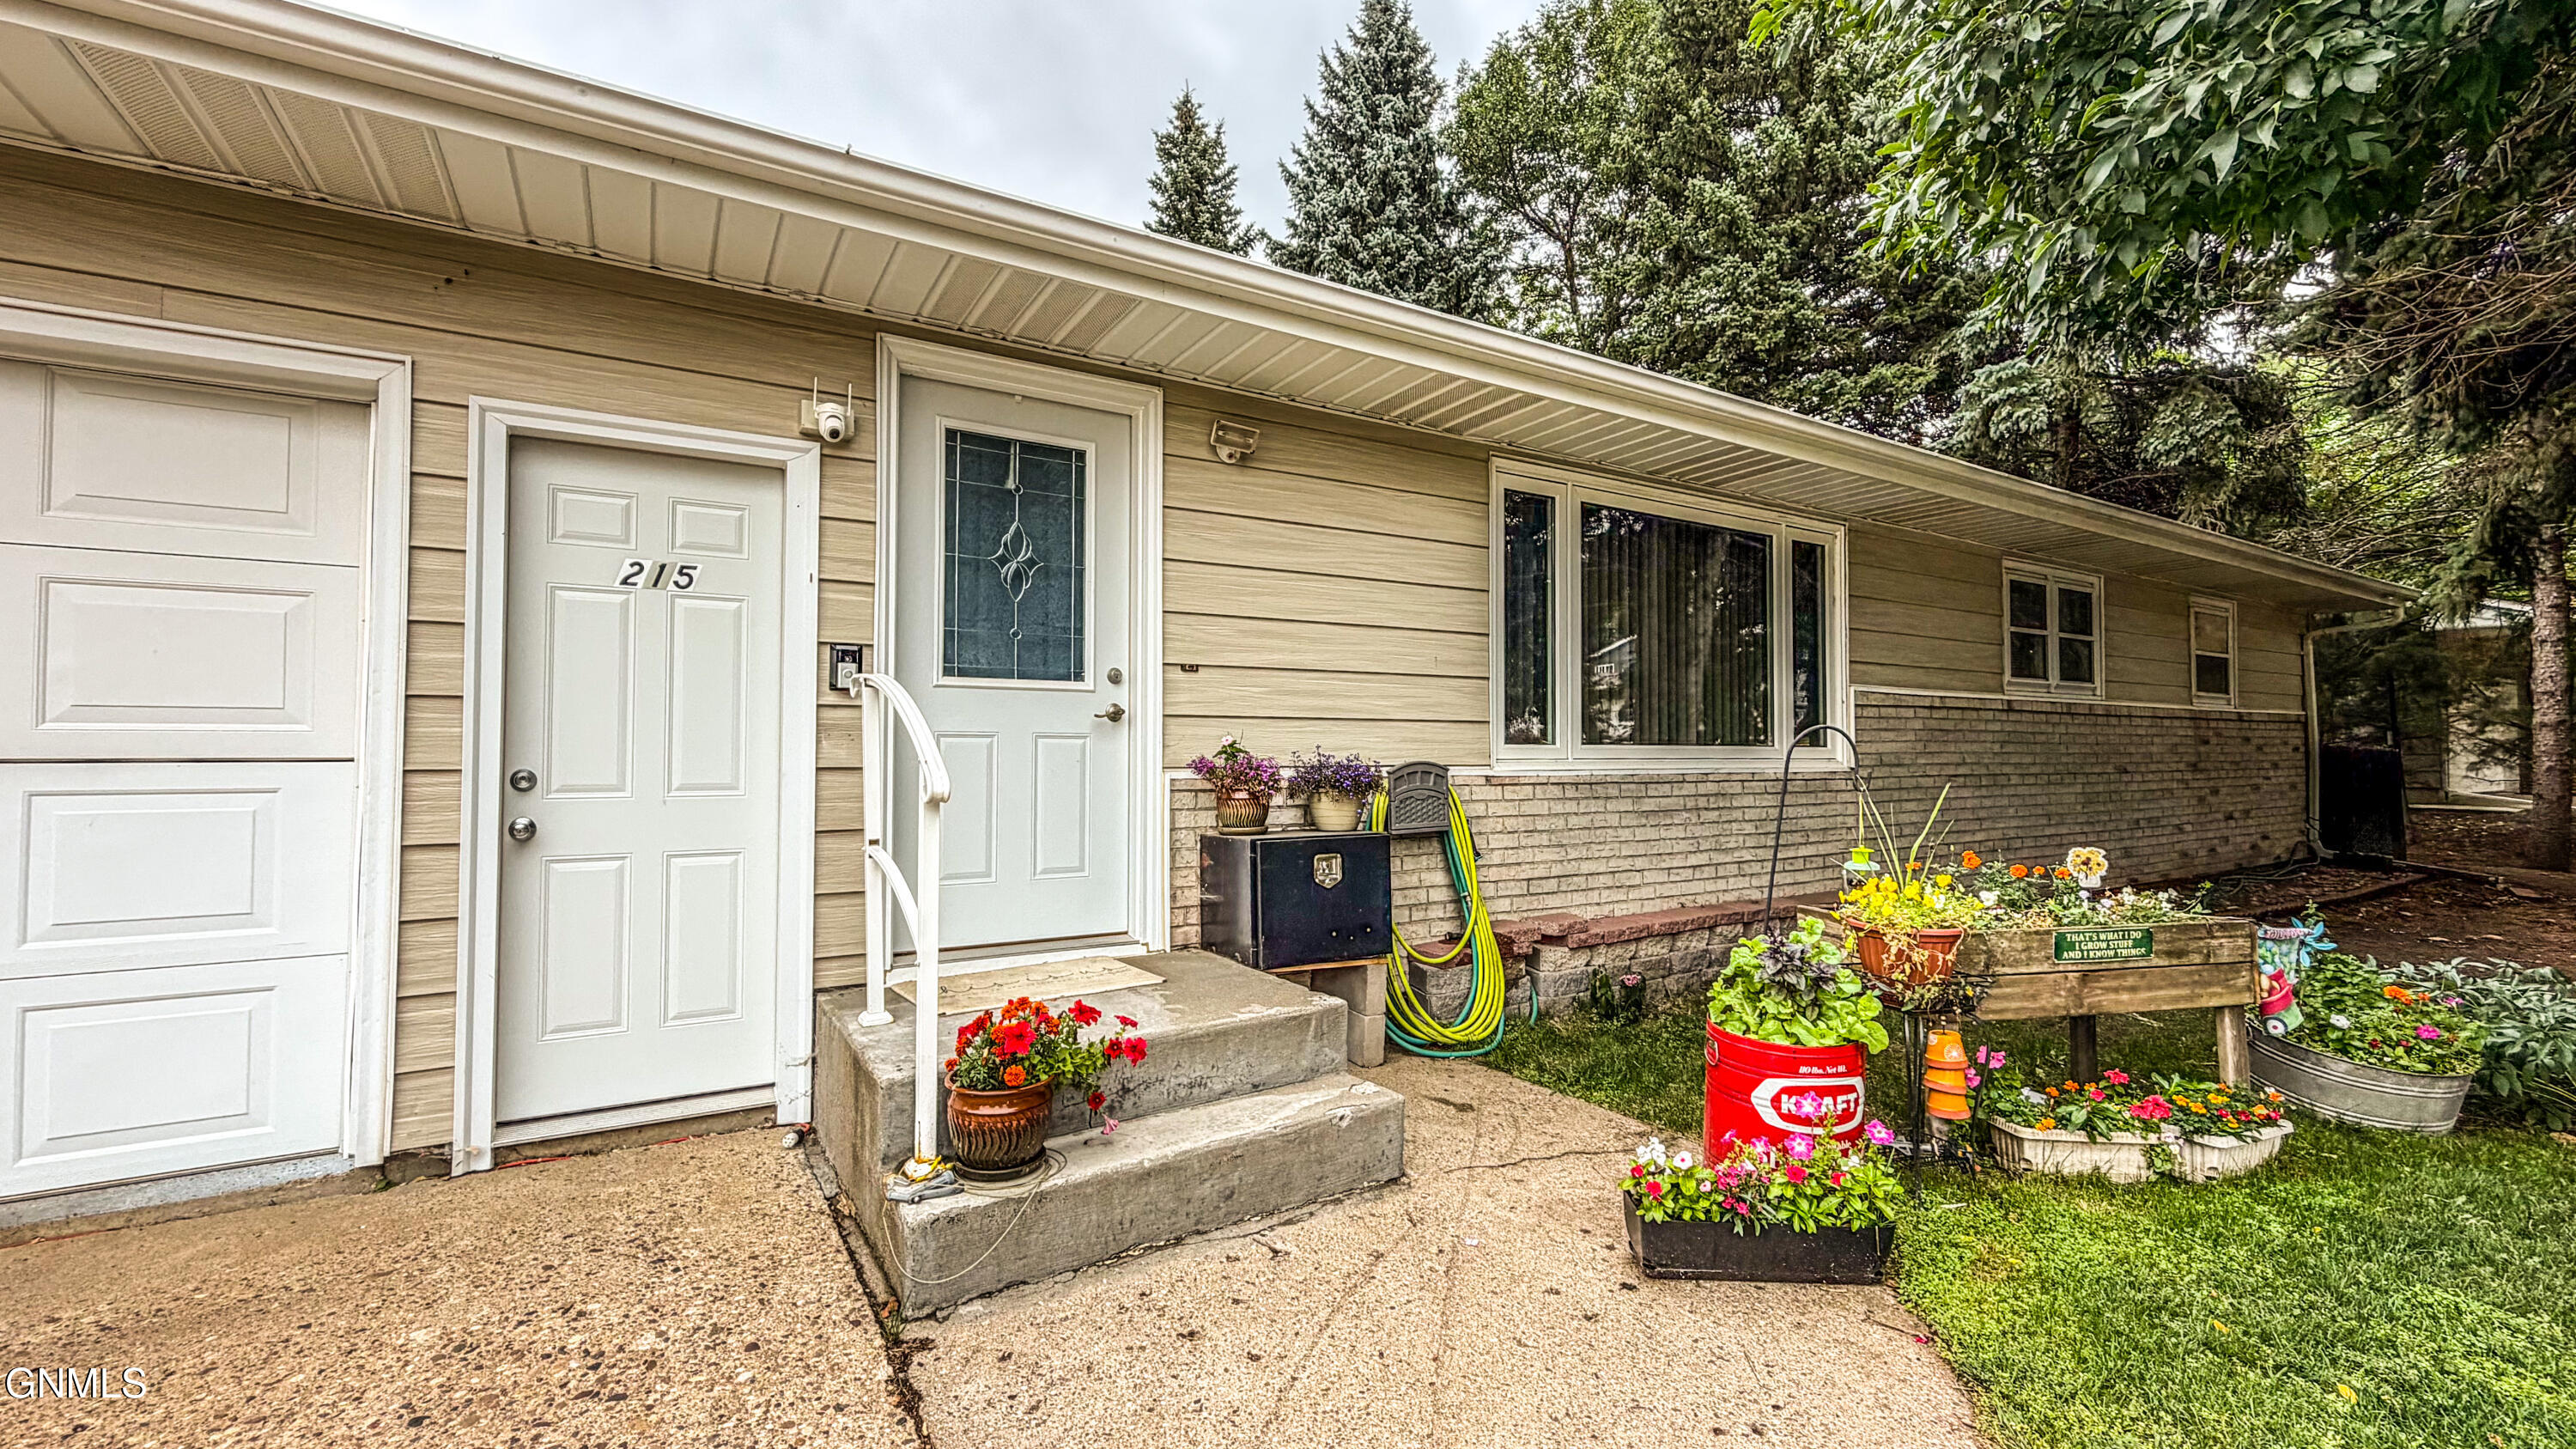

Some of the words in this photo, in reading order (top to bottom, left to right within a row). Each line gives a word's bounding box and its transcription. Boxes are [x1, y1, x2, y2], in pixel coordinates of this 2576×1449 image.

[618, 560, 698, 590] 215
[2066, 933, 2098, 941] THAT'S
[2099, 931, 2123, 941] WHAT
[2081, 941, 2108, 950] GROW
[2109, 940, 2134, 948] STUFF
[2063, 951, 2082, 959] AND
[2083, 950, 2088, 959] I
[2089, 950, 2115, 959] KNOW
[1781, 1092, 1858, 1115] KAFT
